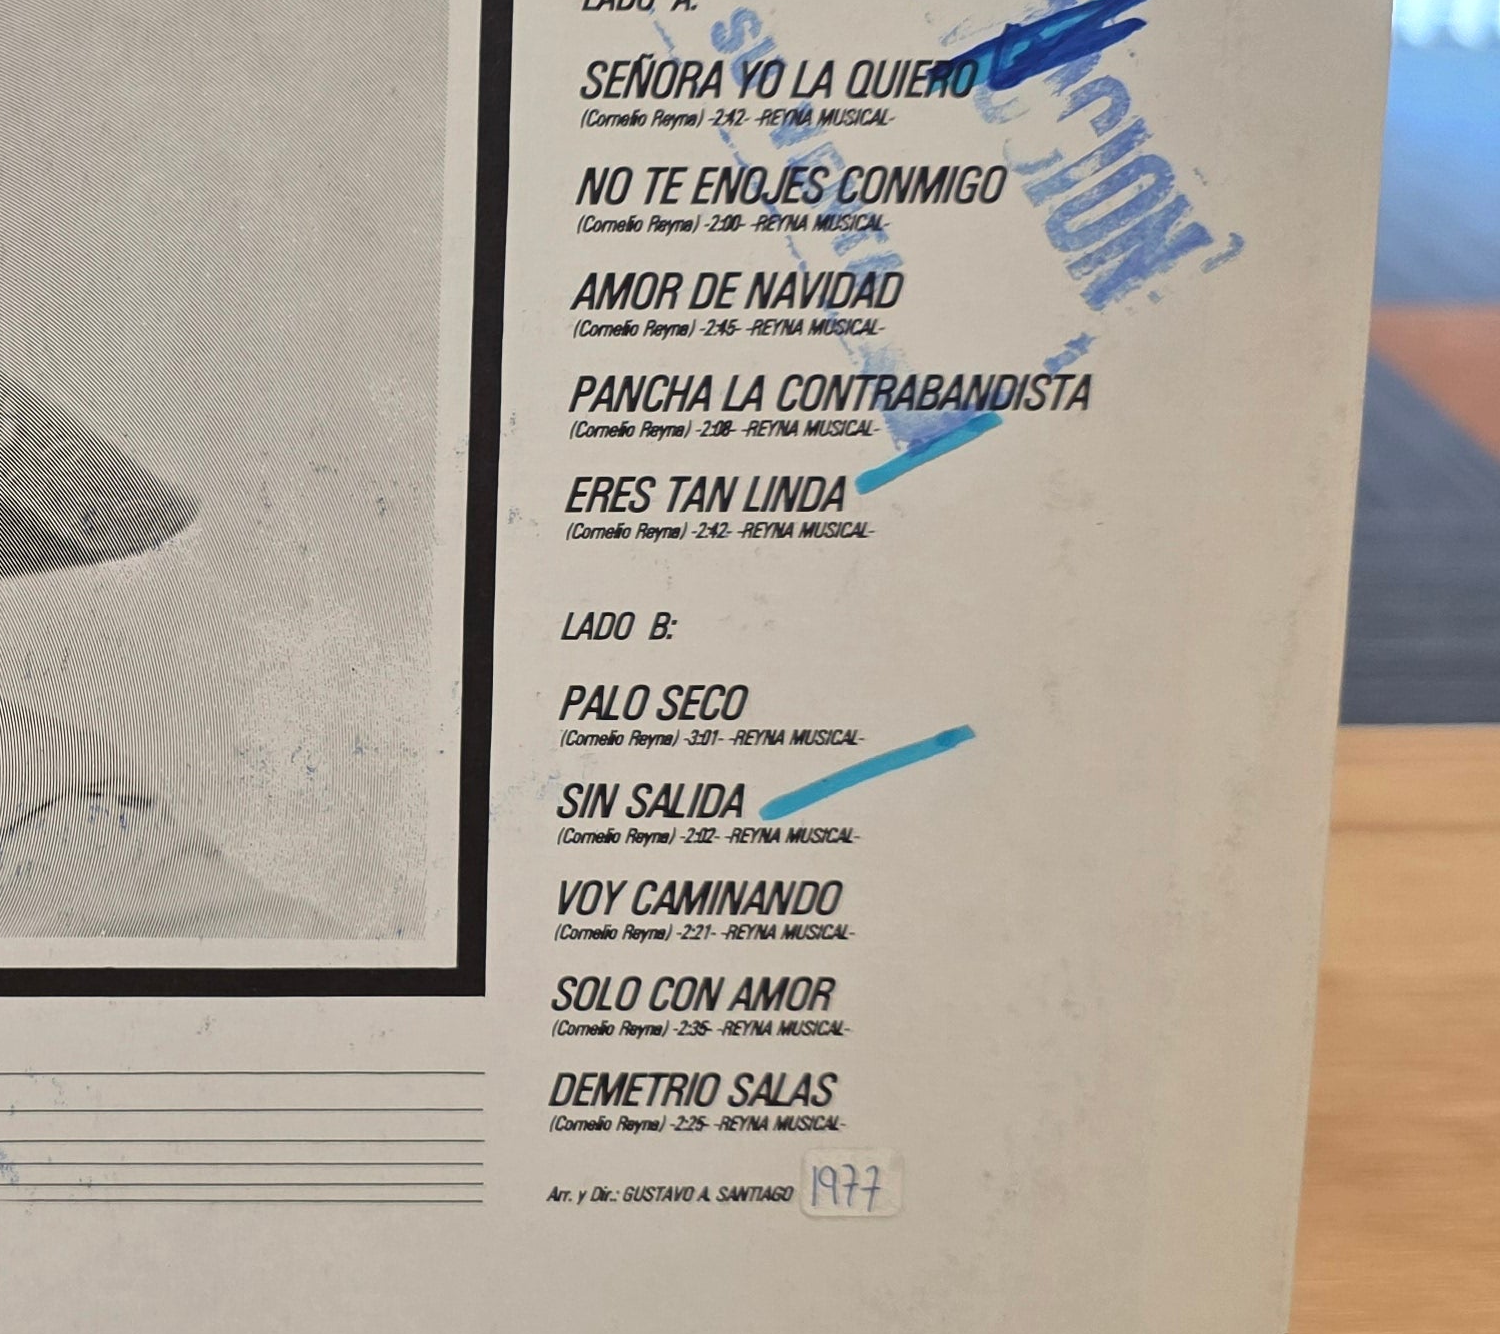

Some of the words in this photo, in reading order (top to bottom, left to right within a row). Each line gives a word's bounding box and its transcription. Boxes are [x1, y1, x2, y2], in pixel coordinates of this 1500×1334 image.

[580, 53, 724, 100] SEÑORA
[739, 59, 786, 99] YO
[790, 60, 834, 98] LA
[846, 55, 979, 99] QUIERO
[580, 108, 648, 128] (Cornelio
[650, 108, 705, 131] Reyna)
[816, 107, 895, 127] MUSICAL-
[575, 166, 634, 206] NO
[644, 166, 689, 205] TE
[691, 165, 830, 205] ENOJES
[837, 165, 1008, 205] CONMIGO
[576, 214, 644, 234] (Cornelio
[646, 214, 701, 236] Reyna)
[811, 213, 890, 232] MUSICAL-
[569, 271, 684, 311] AMOR
[688, 271, 743, 310] DE
[744, 271, 905, 310] NAVIDAD
[573, 319, 640, 339] (Cornelio
[642, 319, 697, 340] Reyna)
[807, 318, 885, 336] MUSICAL-
[568, 374, 713, 413] PANCHA
[721, 374, 765, 412] LA
[776, 373, 1092, 412] CONTRABANDISTA
[569, 420, 636, 440] (Cornelio
[639, 420, 692, 441] Reyna)
[802, 419, 880, 437] MUSICAL-
[564, 475, 657, 514] ERES
[666, 475, 739, 513] TAN
[742, 475, 847, 513] LINDA
[565, 522, 632, 541] (Cornelio
[634, 521, 688, 543] Reyna)
[797, 521, 875, 539] MUSICAL-
[560, 611, 636, 641] LADO
[648, 611, 678, 640] B:
[558, 684, 651, 721] PALO
[656, 684, 749, 721] SECO
[560, 729, 625, 748] (Cornelio
[627, 729, 680, 750] Reyna)
[788, 728, 865, 746] MUSICAL-
[556, 782, 620, 819] SIN
[625, 782, 745, 819] SALIDA
[557, 827, 622, 845] (Cornelio
[624, 827, 677, 848] Reyna)
[784, 827, 860, 844] MUSICAL-
[557, 879, 628, 916] VOY
[631, 879, 844, 916] CAMINANDO
[554, 923, 619, 941] (Cornelio
[621, 923, 673, 944] Reyna)
[780, 923, 855, 941] MUSICAL-
[551, 976, 642, 1012] SOLO
[648, 976, 725, 1012] CON
[727, 976, 836, 1012] AMOR
[551, 1019, 616, 1037] (Cornelio
[618, 1019, 670, 1040] Reyna)
[776, 1019, 850, 1037] MUSICAL-
[548, 1072, 722, 1108] DEMETRIO
[727, 1072, 838, 1108] SALAS
[549, 1115, 613, 1133] (Cornelio
[615, 1115, 667, 1135] Reyna)
[772, 1114, 846, 1132] MUSICAL-
[546, 1186, 573, 1202] Arr.
[576, 1190, 587, 1205] y
[589, 1186, 620, 1202] Dir.:
[622, 1185, 696, 1203] GUSTAVO
[696, 1186, 711, 1203] A.
[715, 1185, 795, 1203] SANTIAGO
[811, 1163, 881, 1212] 1977
